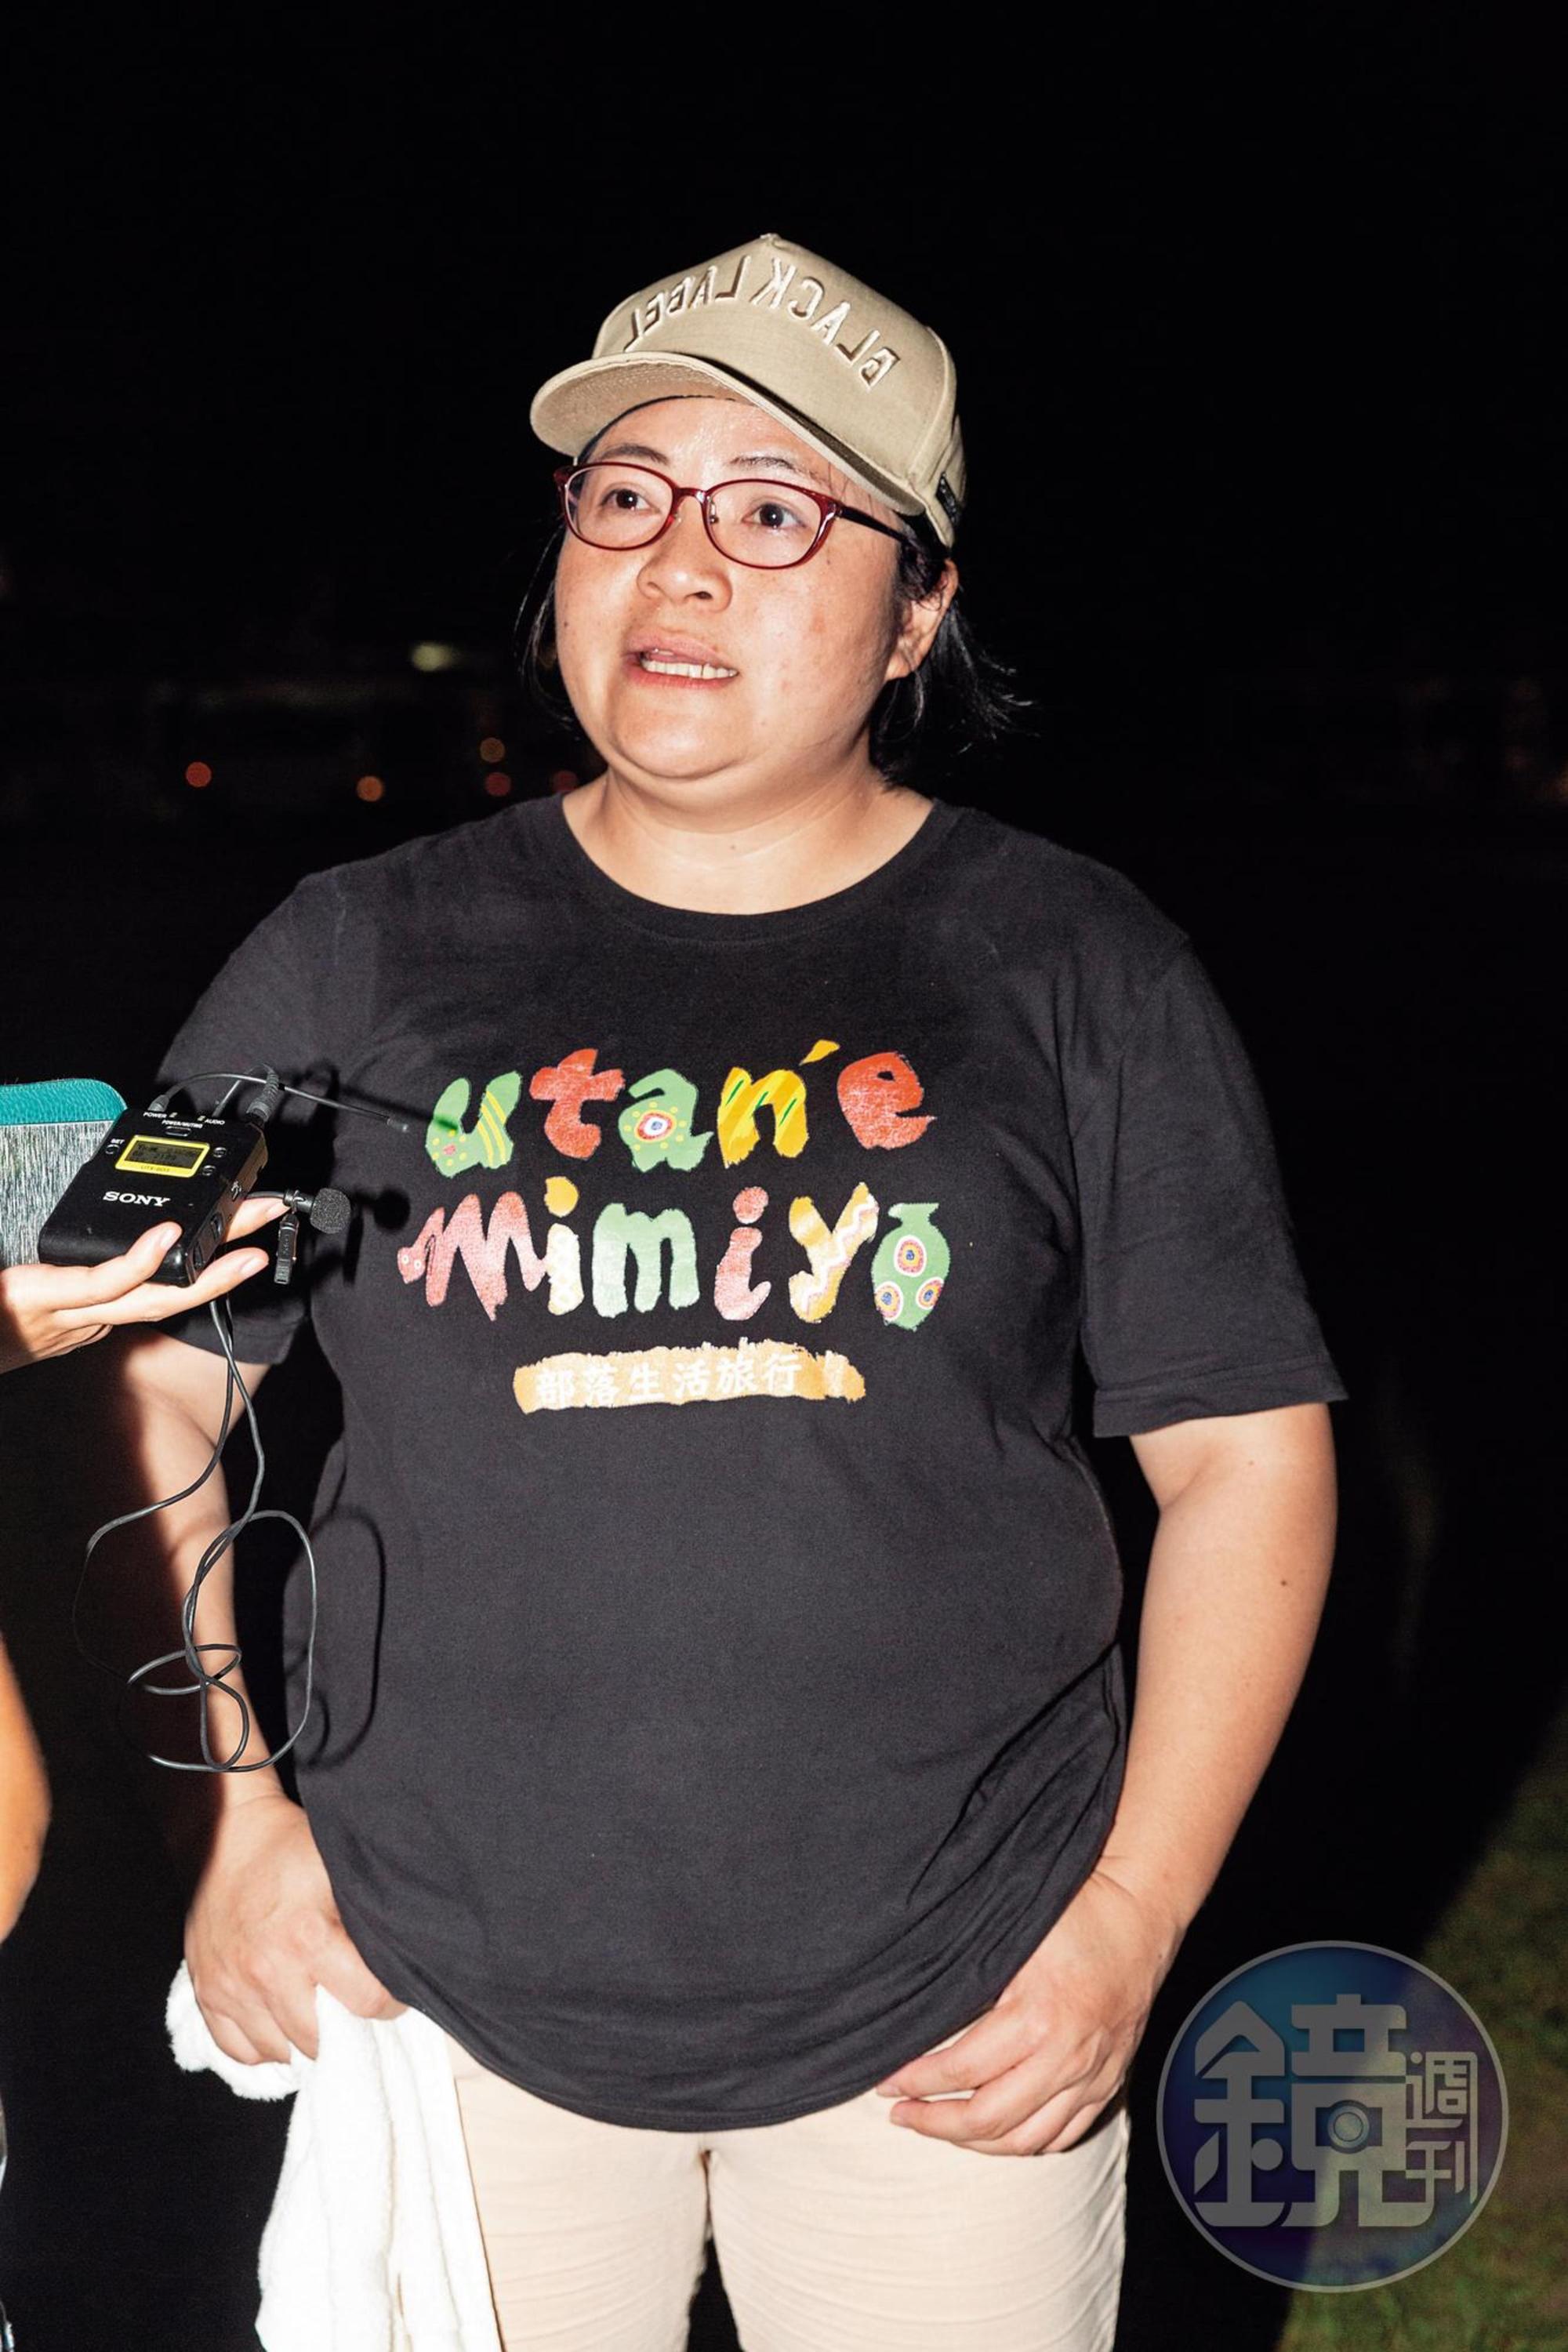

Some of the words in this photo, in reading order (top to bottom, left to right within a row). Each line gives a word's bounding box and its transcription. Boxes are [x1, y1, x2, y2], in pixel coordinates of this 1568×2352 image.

[103, 1192, 170, 1207] SONY
[535, 1352, 801, 1408] 部落生活旅行
